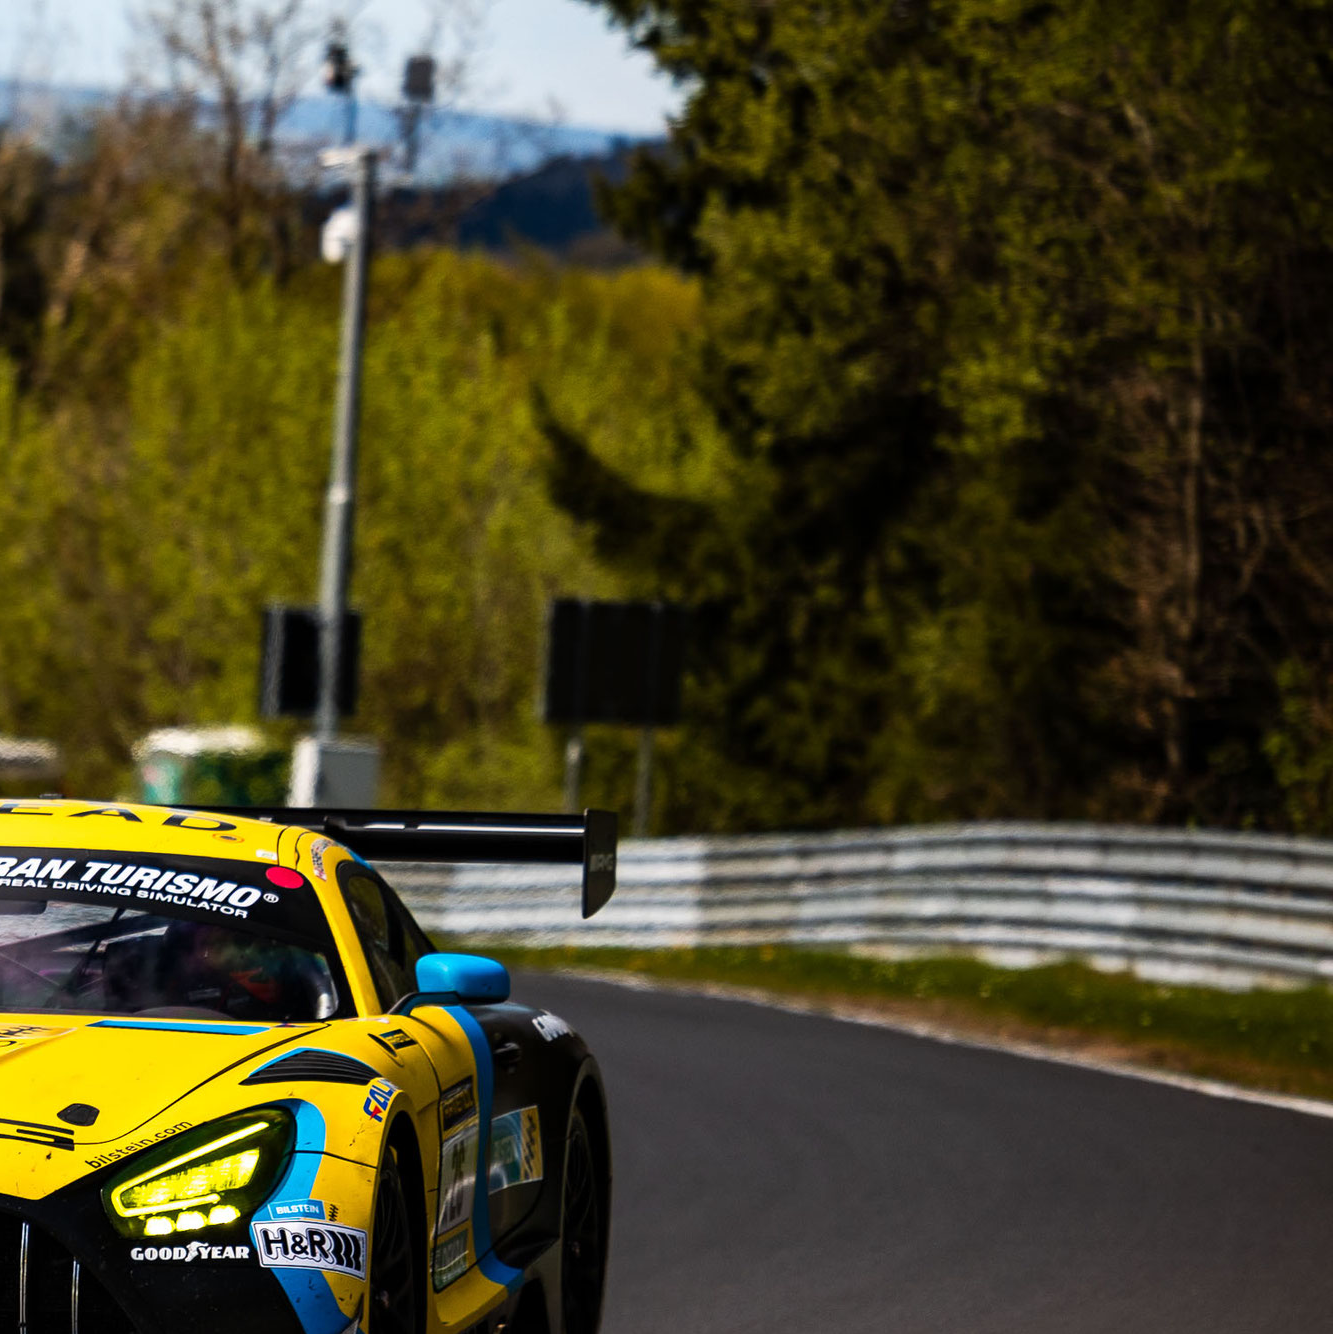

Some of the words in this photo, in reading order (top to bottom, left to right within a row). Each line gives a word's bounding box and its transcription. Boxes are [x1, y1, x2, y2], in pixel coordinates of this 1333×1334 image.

[51, 881, 132, 897] DRIVING
[136, 890, 249, 919] SIMULATOR
[85, 1120, 193, 1169] bilstein.com
[275, 1203, 320, 1215] BILSTEIN
[130, 1241, 250, 1263] GOODYEAR
[262, 1228, 333, 1260] H&R
